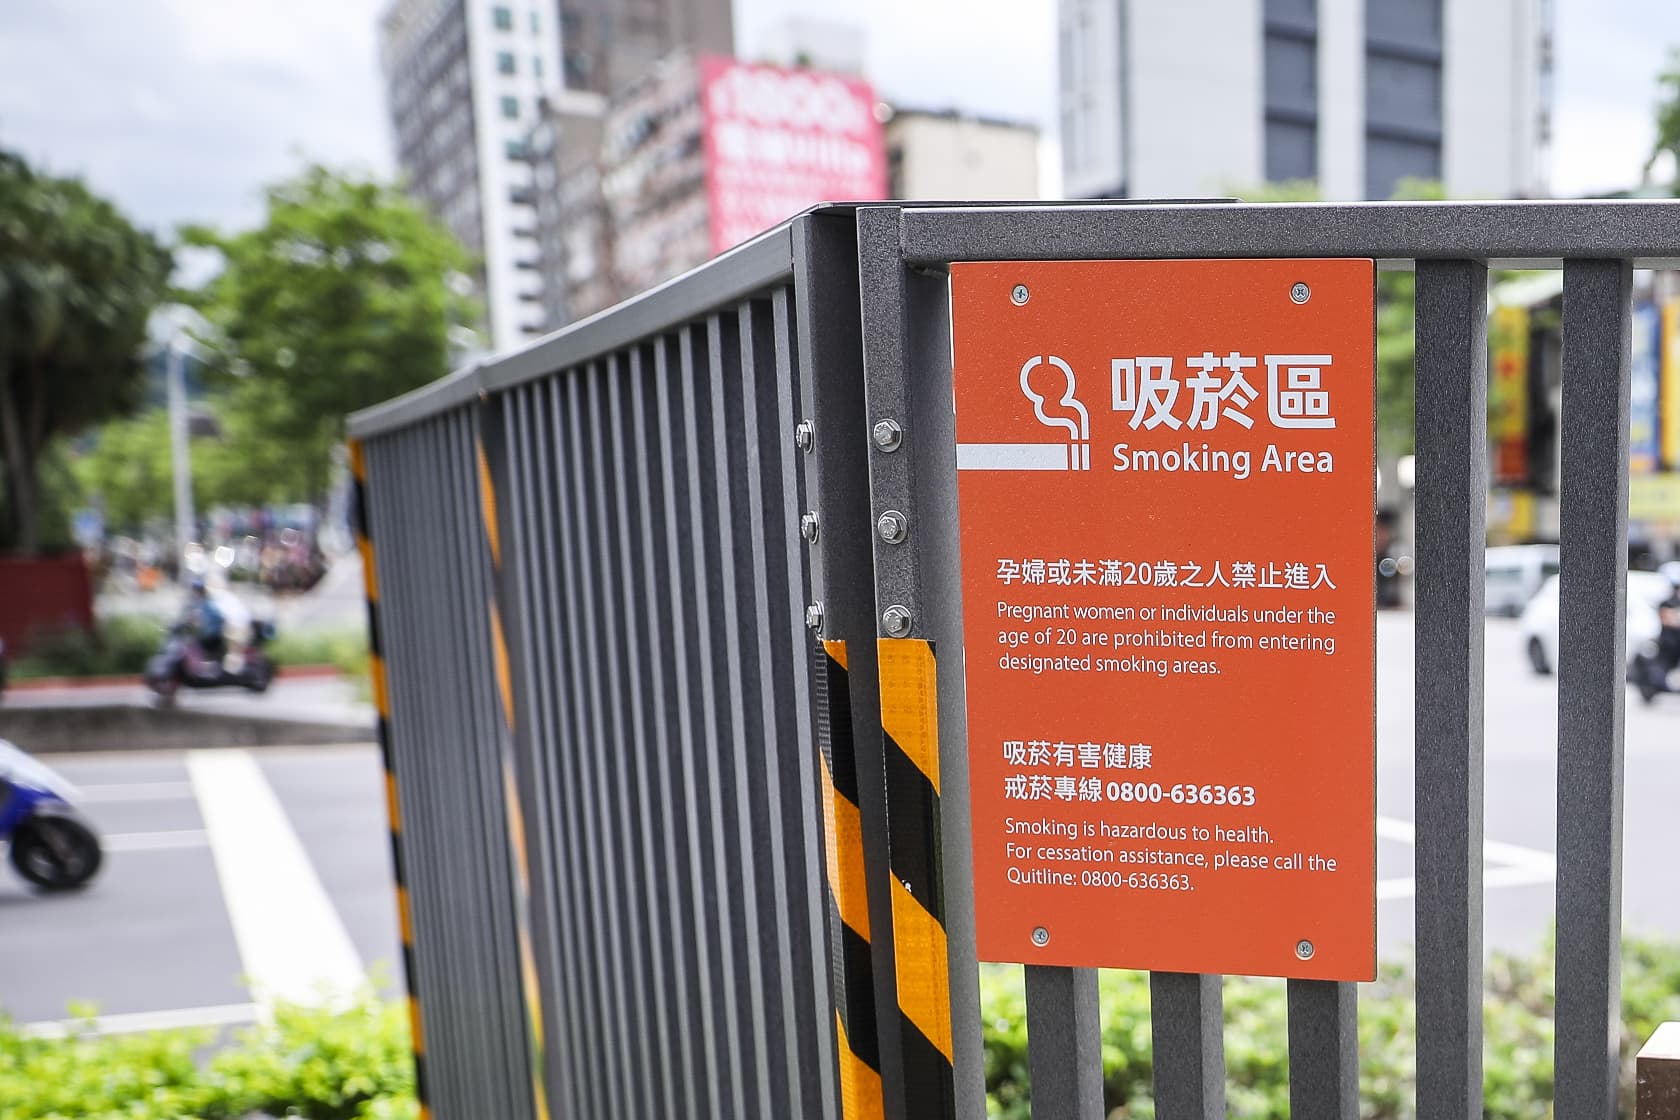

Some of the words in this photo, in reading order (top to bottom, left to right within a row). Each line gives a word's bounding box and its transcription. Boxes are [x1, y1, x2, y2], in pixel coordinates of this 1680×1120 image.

[1111, 351, 1337, 431] 吸菸區
[1113, 442, 1251, 480] Smoking
[1260, 444, 1333, 473] Area
[996, 558, 1337, 590] 孕婦或未滿20歲之人禁止進入
[997, 601, 1070, 623] Pregnant
[1073, 606, 1135, 620] women
[1139, 607, 1157, 621] or
[1161, 603, 1249, 623] individuals
[1253, 605, 1304, 624] under
[1306, 606, 1336, 625] the
[998, 631, 1030, 648] age
[1034, 626, 1053, 645] of
[1056, 628, 1077, 645] 20
[1081, 632, 1109, 646] are
[1113, 629, 1206, 650] prohibited
[1211, 630, 1253, 649] from
[1258, 633, 1335, 655] entering
[999, 652, 1091, 675] designated
[1095, 654, 1168, 677] smoking
[1172, 660, 1221, 674] areas.
[1003, 739, 1153, 770] 吸菸有害健康
[1004, 773, 1103, 803] 戒菸專線
[1106, 781, 1256, 806] 0800-636363
[1005, 817, 1078, 841] Smoking
[1083, 820, 1096, 837] is
[1100, 820, 1187, 841] hazardous
[1191, 825, 1210, 841] to
[1215, 824, 1274, 844] health.
[1006, 842, 1033, 859] For
[1036, 845, 1114, 863] cessation
[1119, 847, 1209, 869] assistance,
[1214, 850, 1269, 871] please
[1273, 852, 1302, 870] call
[1307, 853, 1337, 872] the
[1007, 866, 1077, 886] Quitline:
[1081, 870, 1194, 891] 0800-636363.
